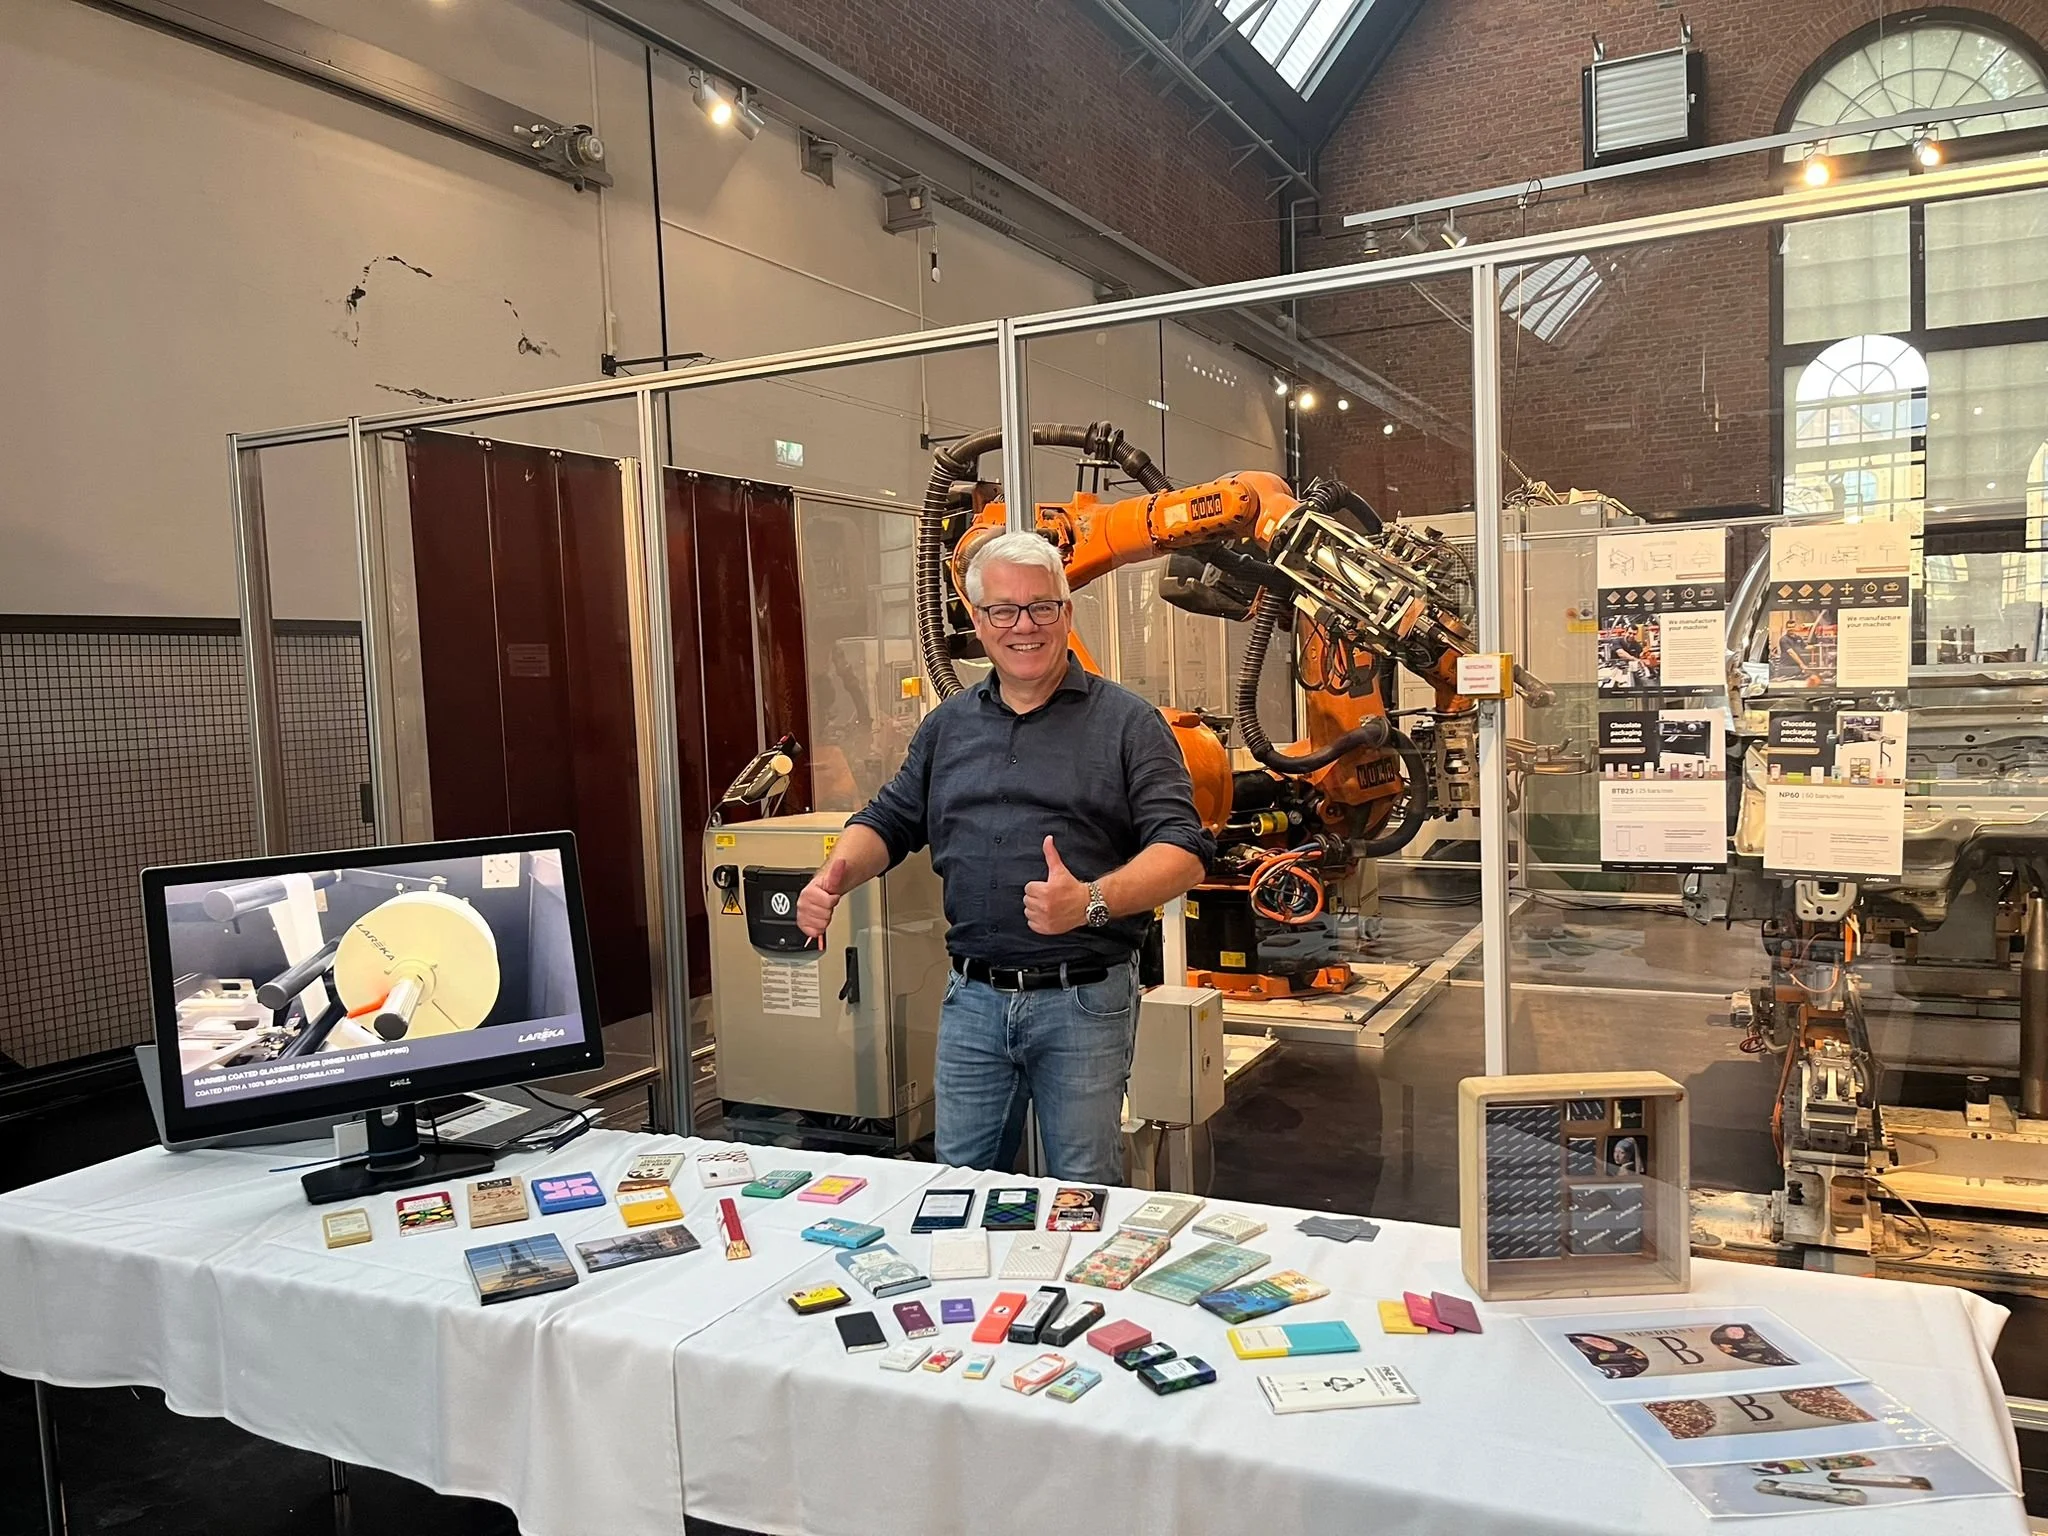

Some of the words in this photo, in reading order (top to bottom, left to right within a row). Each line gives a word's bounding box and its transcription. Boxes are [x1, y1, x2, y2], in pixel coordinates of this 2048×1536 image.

[1191, 496, 1222, 518] KUKA
[1610, 729, 1642, 737] packaging
[1358, 761, 1395, 788] KUKA
[355, 923, 395, 961] LAREKA
[518, 1027, 566, 1044] LAREKA
[194, 1074, 227, 1086] BARRIER
[228, 1070, 258, 1081] COATED
[259, 1064, 295, 1077] GLASSINE
[296, 1060, 321, 1070] PAPER
[321, 1055, 346, 1068] (INNER
[347, 1052, 369, 1062] LAYER
[370, 1046, 410, 1059] WRAPPING)
[195, 1087, 222, 1097] COATED
[223, 1085, 240, 1094] WITH
[248, 1081, 265, 1089] 100%
[265, 1076, 299, 1086] BIO-BASED
[299, 1068, 345, 1080] FORMULATION
[472, 1188, 521, 1202] 55%
[1651, 1336, 1705, 1366] B
[1727, 1394, 1774, 1422] B
